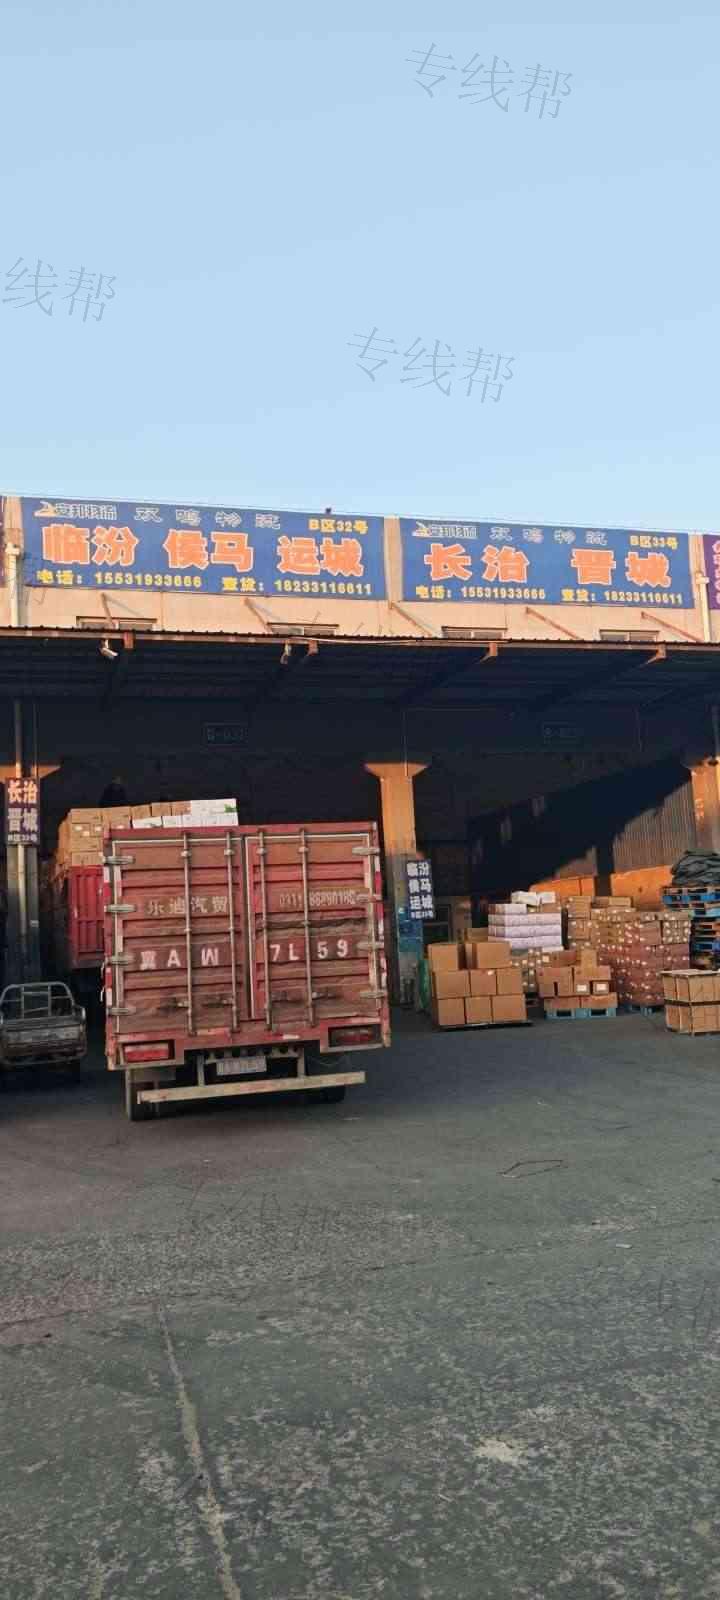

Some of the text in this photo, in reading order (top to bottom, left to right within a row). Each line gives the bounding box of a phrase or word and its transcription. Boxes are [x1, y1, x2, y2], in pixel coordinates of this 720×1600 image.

[308, 518, 368, 534] B区32号
[42, 523, 364, 577] 临汾 侯马 运城
[424, 543, 530, 583] 长治
[571, 548, 672, 588] 晋城
[8, 780, 37, 804] 长治
[8, 808, 38, 832] 晋城
[407, 862, 429, 877] 临汾
[410, 895, 433, 909] 运城
